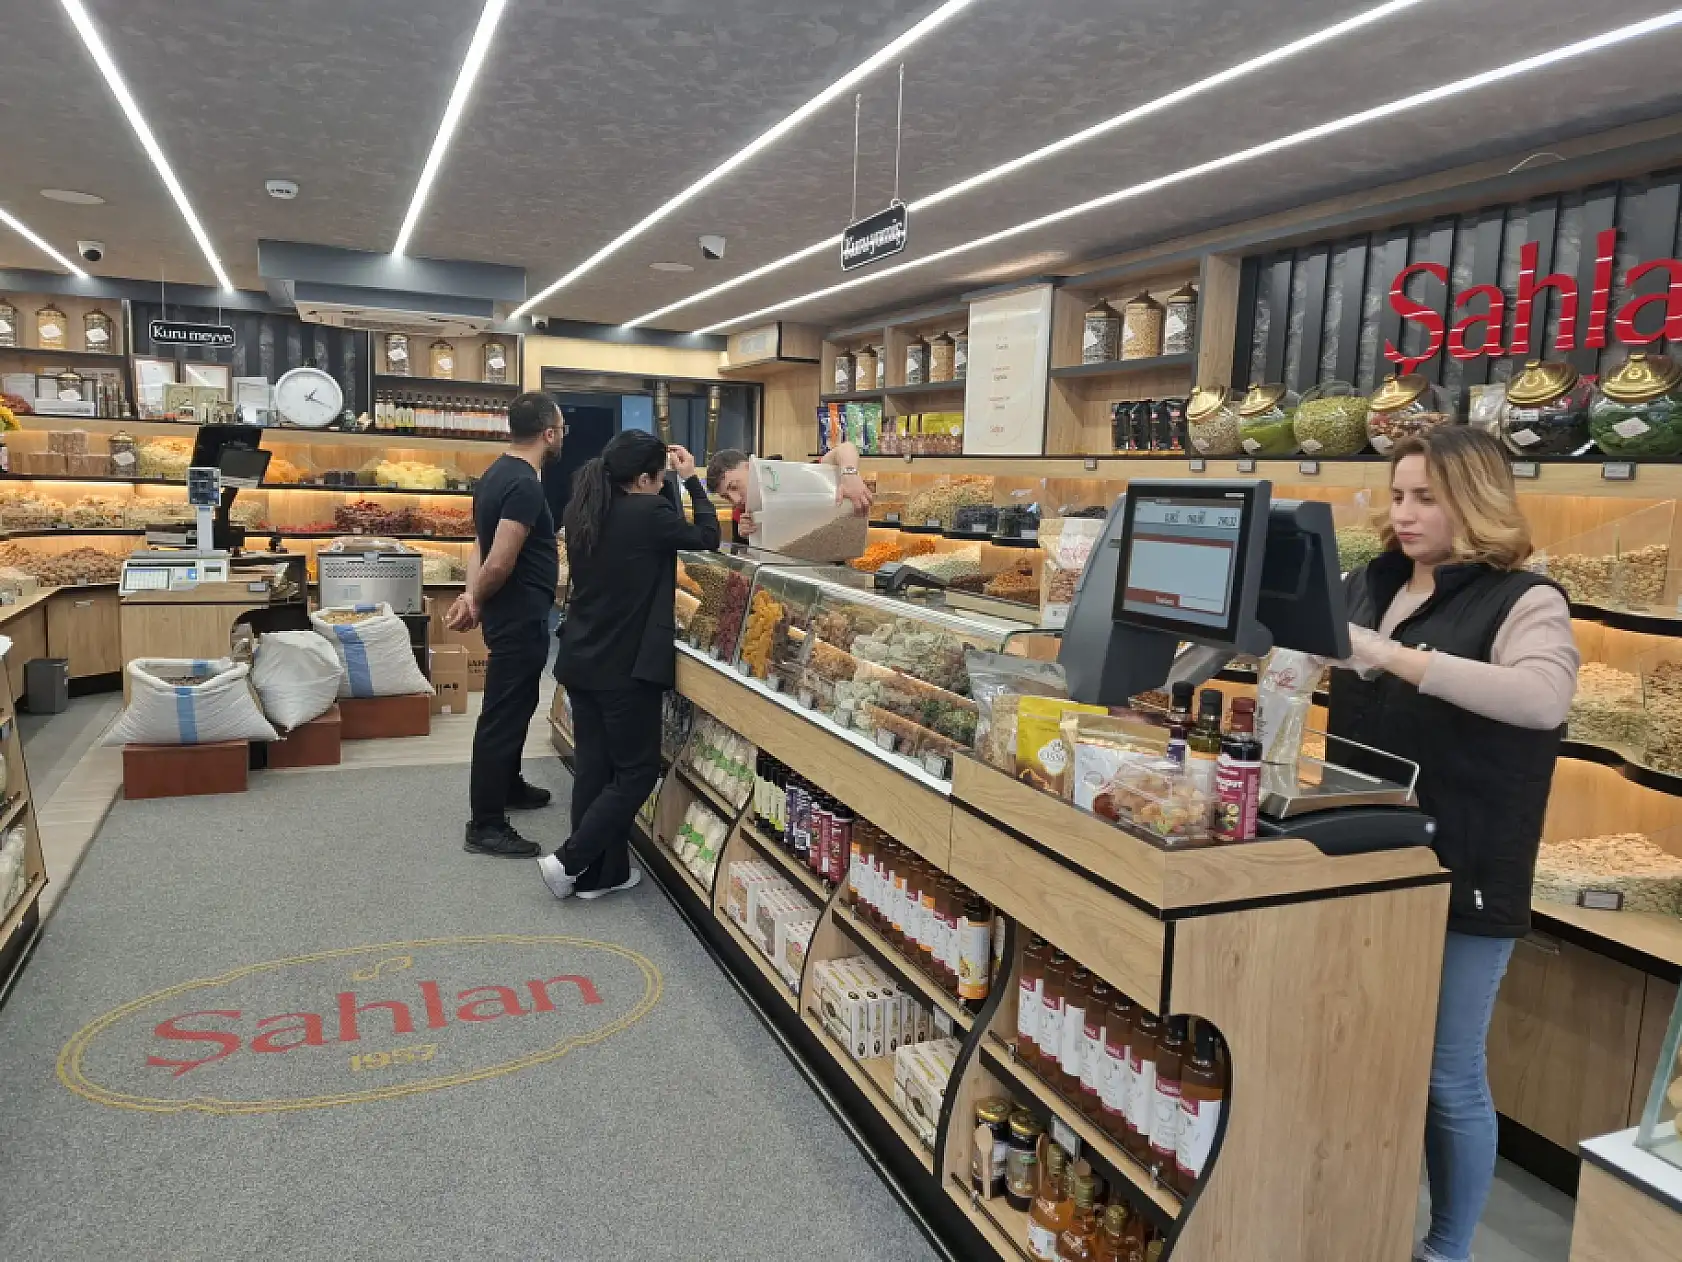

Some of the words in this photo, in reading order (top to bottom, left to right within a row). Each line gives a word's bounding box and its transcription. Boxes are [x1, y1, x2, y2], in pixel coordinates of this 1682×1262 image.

[152, 325, 187, 339] Kuru
[188, 330, 233, 344] meyve
[144, 974, 605, 1077] Şahlan
[350, 1041, 440, 1072] 1957
